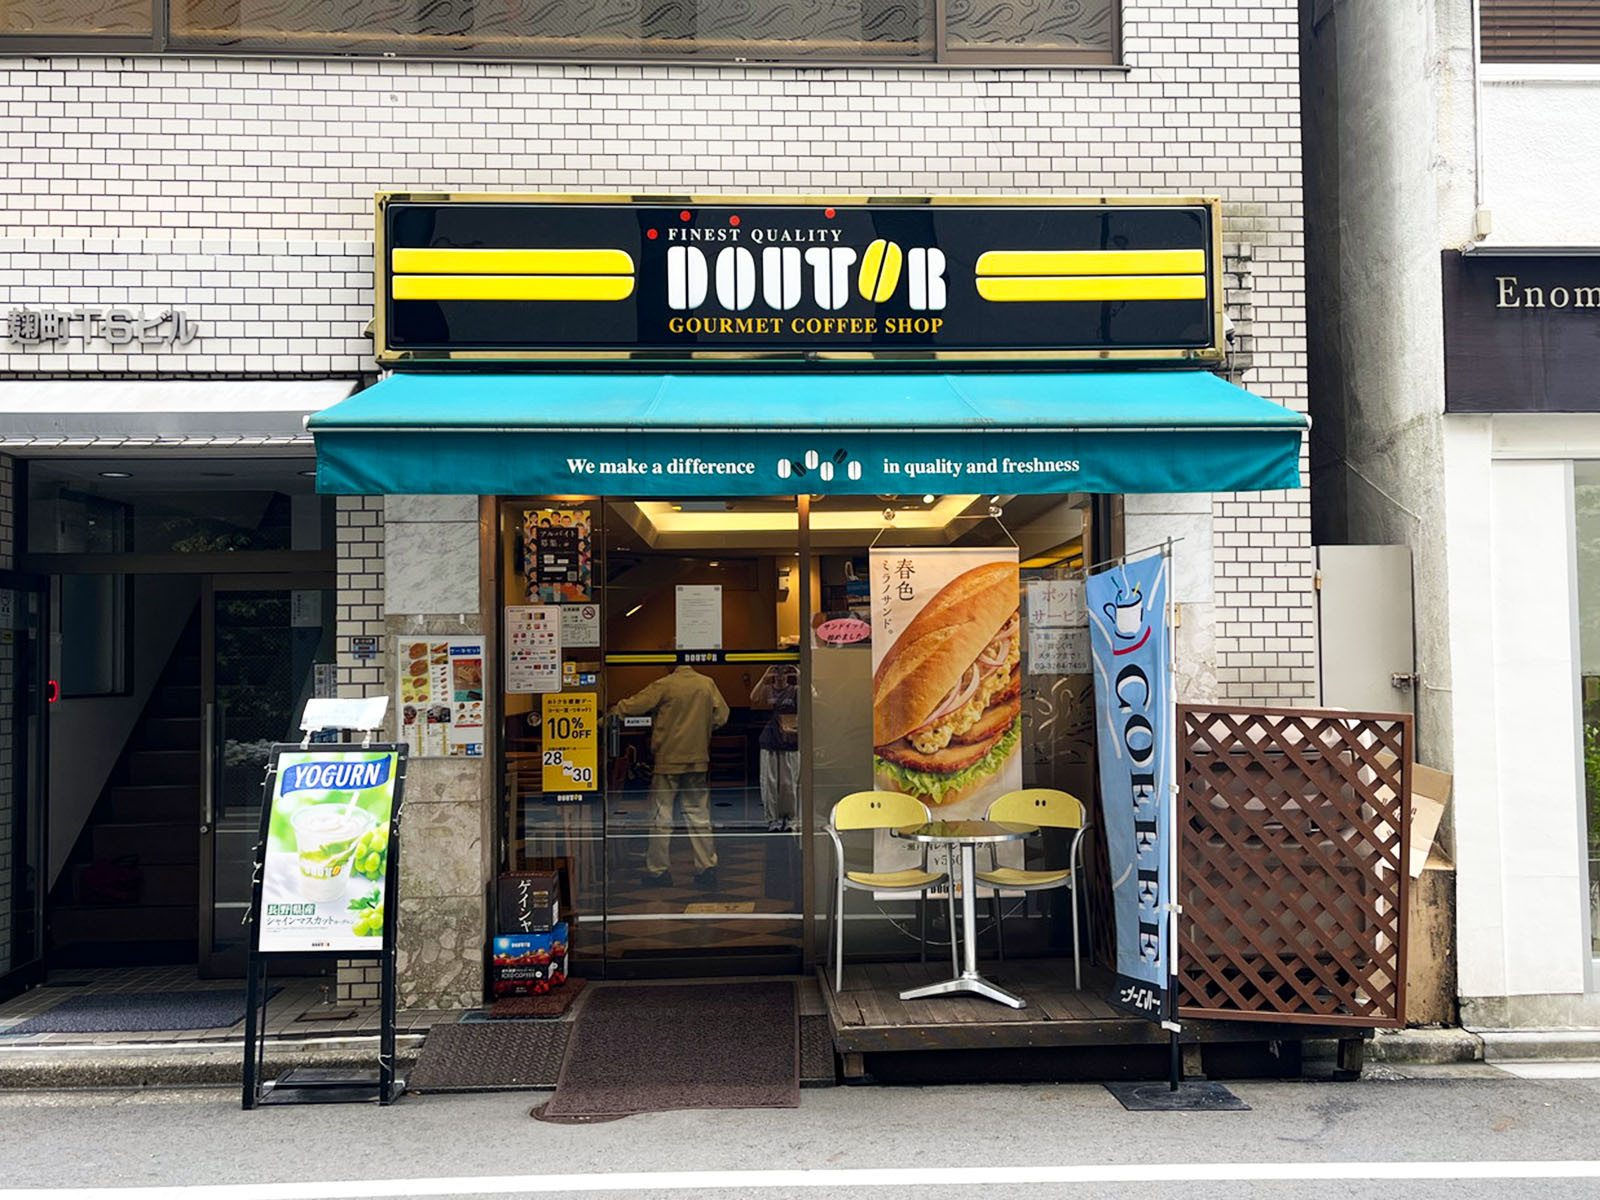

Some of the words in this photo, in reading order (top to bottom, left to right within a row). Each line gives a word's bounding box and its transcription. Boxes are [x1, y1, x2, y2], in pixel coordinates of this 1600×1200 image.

[668, 228, 741, 241] FINEST
[751, 228, 842, 243] QUALITY
[667, 239, 947, 311] DOUTOR
[1496, 277, 1600, 308] Enom
[668, 317, 784, 334] GOURMET
[791, 317, 877, 334] COFFEE
[885, 317, 944, 334] SHOP
[567, 458, 595, 474] We
[600, 458, 648, 474] make
[652, 462, 663, 474] a
[667, 458, 755, 474] difference
[883, 458, 900, 474] in
[904, 458, 962, 478] quality
[966, 458, 998, 474] and
[1002, 457, 1080, 473] freshness
[894, 558, 916, 601] 春色
[571, 730, 592, 739] OFF
[543, 751, 562, 766] 28
[294, 763, 381, 788] YOGURN
[572, 767, 592, 782] 30
